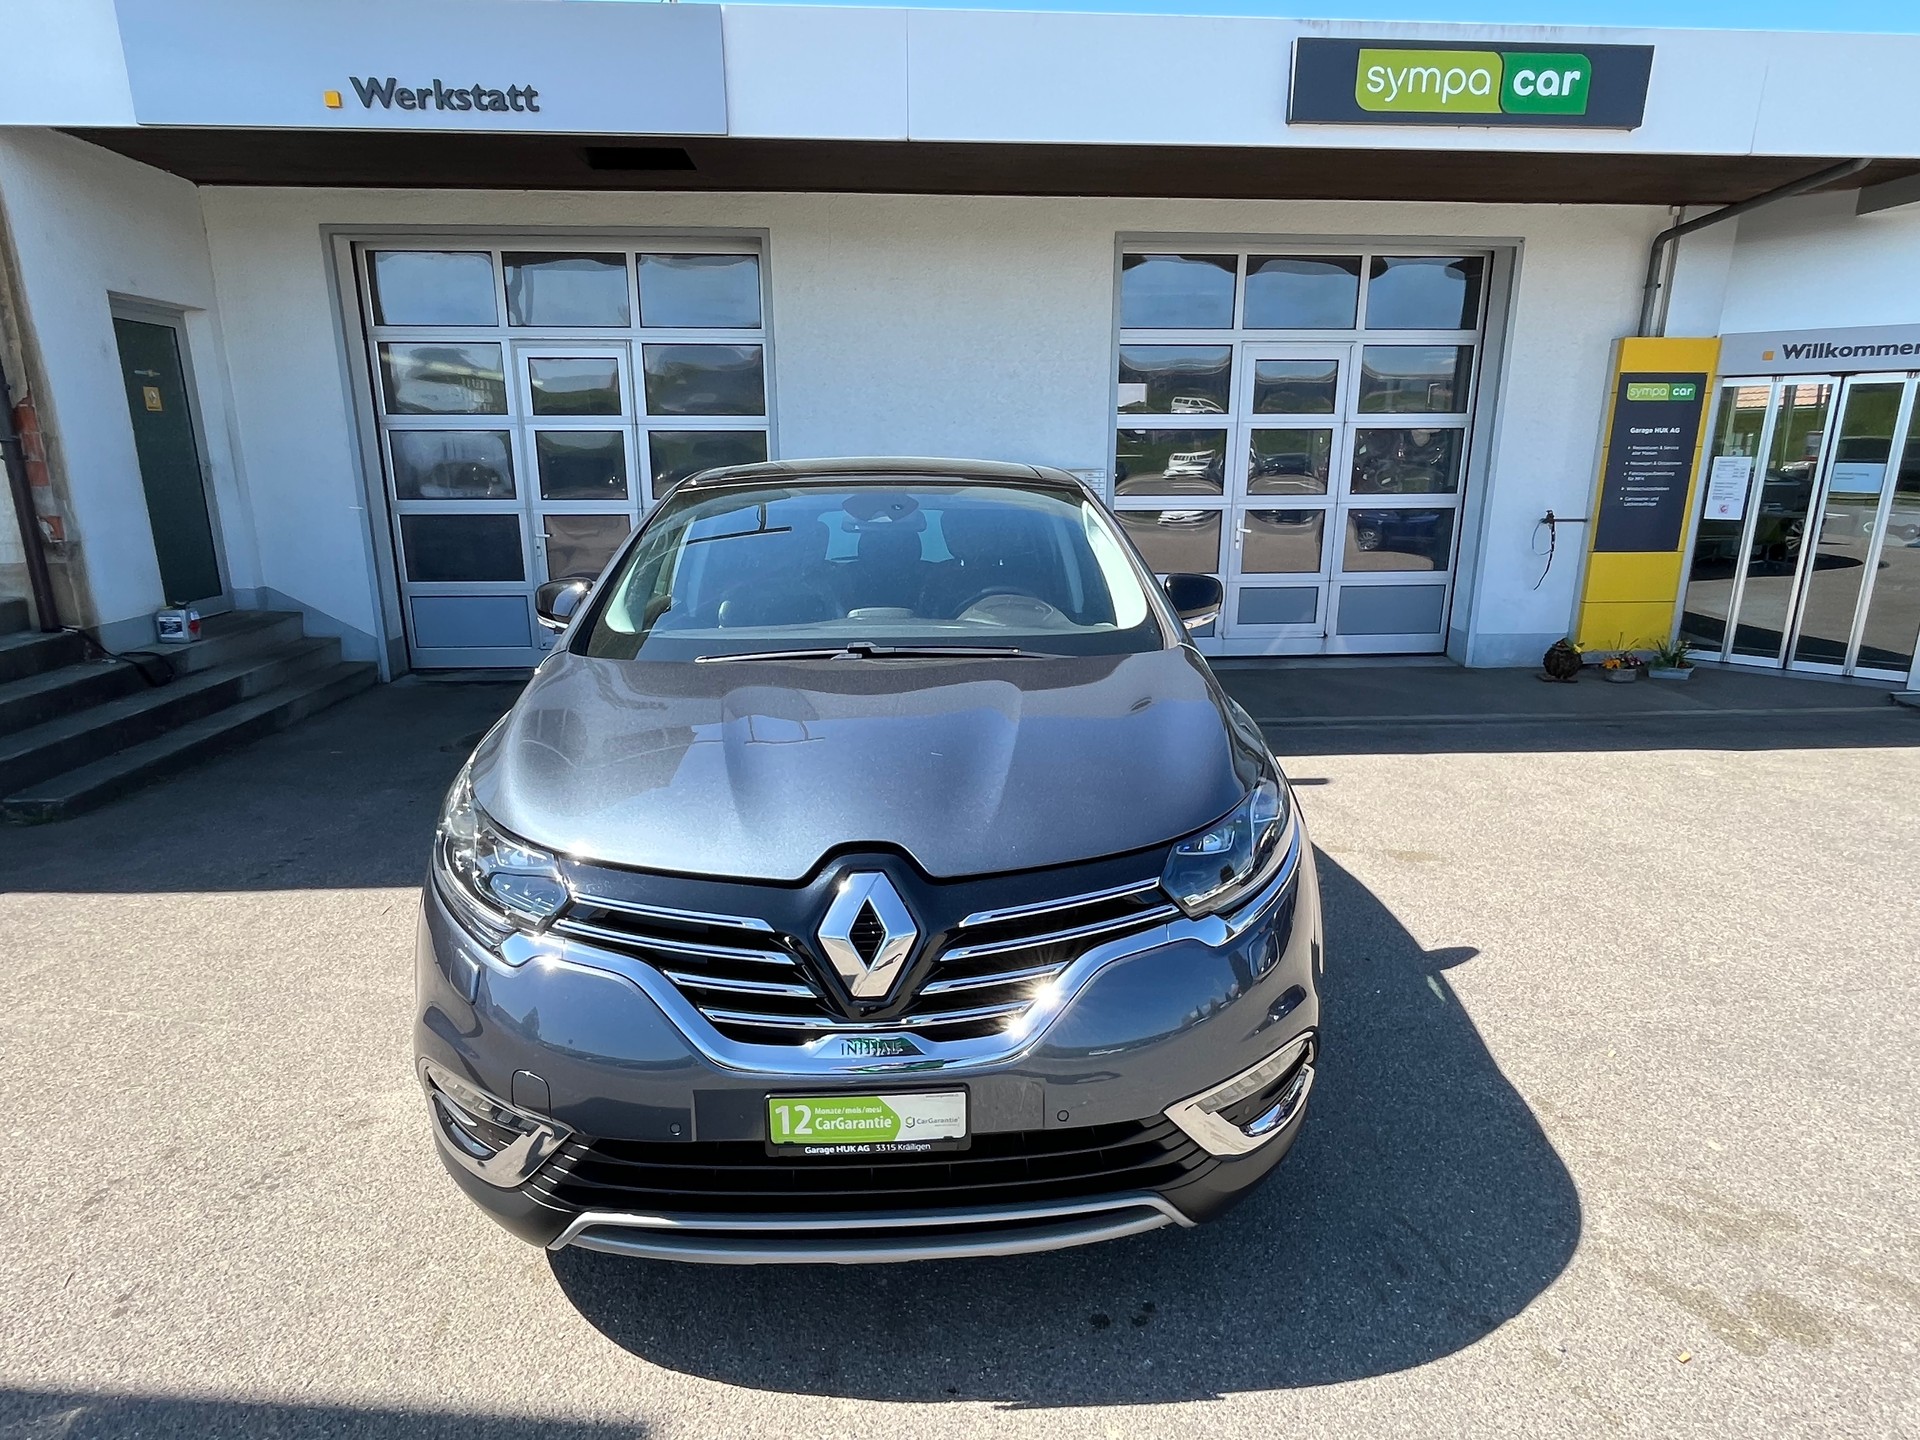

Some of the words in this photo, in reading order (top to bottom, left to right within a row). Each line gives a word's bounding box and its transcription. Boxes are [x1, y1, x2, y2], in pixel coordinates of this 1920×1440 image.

[349, 76, 540, 112] Werkstatt
[1366, 65, 1491, 103] sympa
[1512, 68, 1582, 97] car
[1629, 386, 1667, 398] sympa
[1672, 387, 1693, 396] car
[775, 1105, 813, 1135] 12
[815, 1116, 892, 1131] CarGarantie
[804, 1146, 834, 1155] Garage
[836, 1145, 856, 1153] HUK
[875, 1144, 896, 1152] 3315
